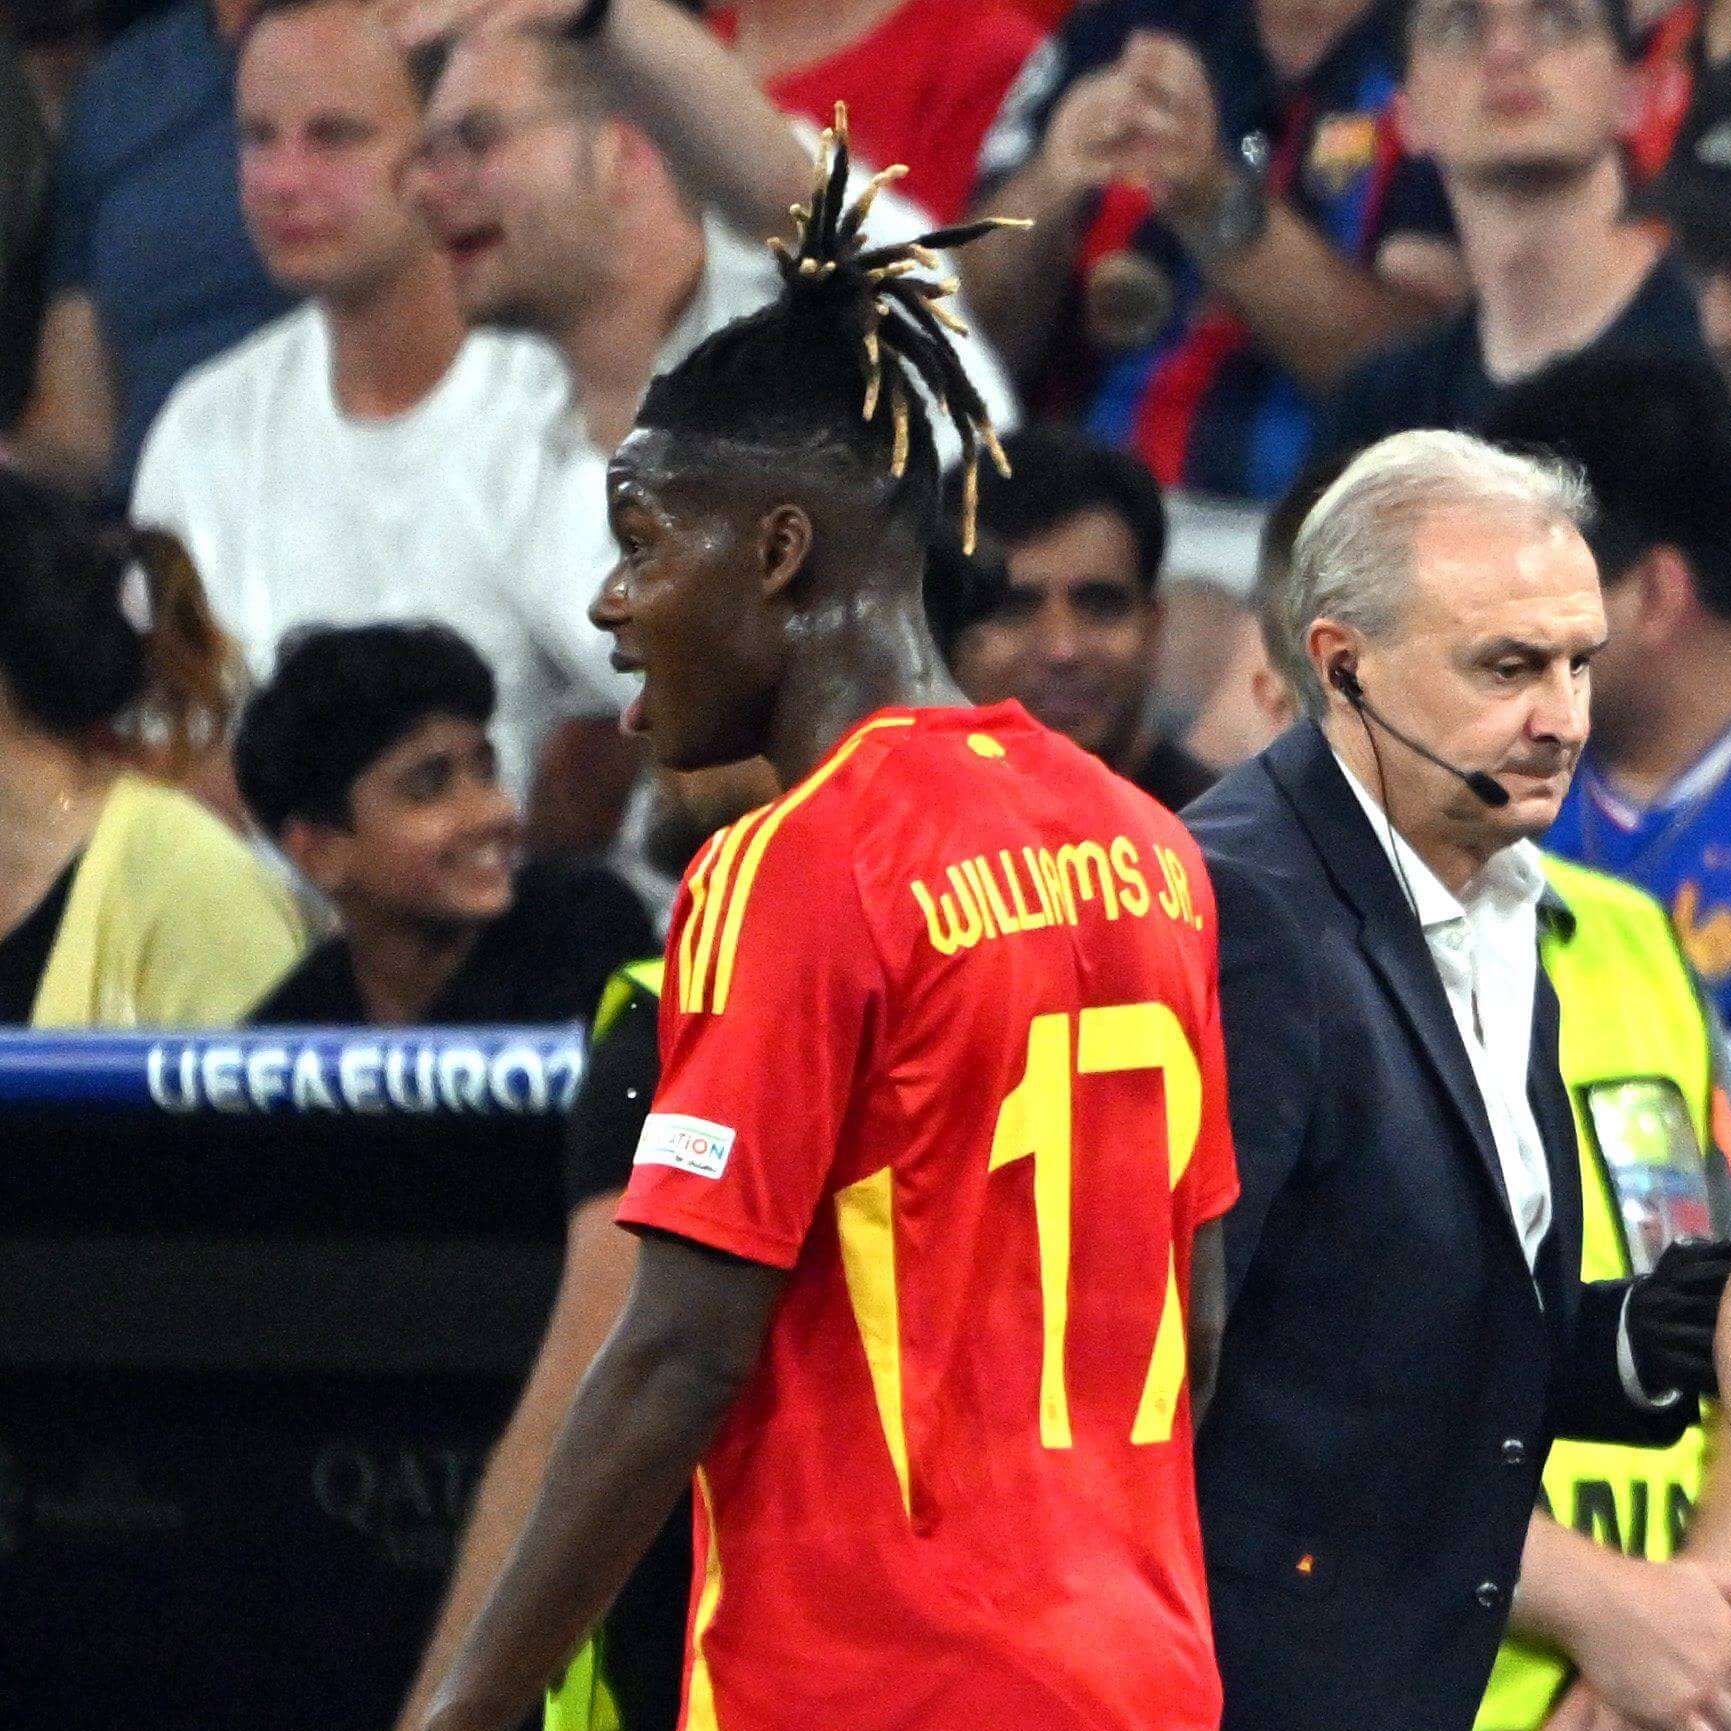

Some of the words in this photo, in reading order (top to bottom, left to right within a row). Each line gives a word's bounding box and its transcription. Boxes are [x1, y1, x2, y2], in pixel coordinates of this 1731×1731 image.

[910, 835, 1151, 956] WILLIAMS
[1157, 842, 1203, 933] JR.
[987, 1000, 1204, 1450] 17
